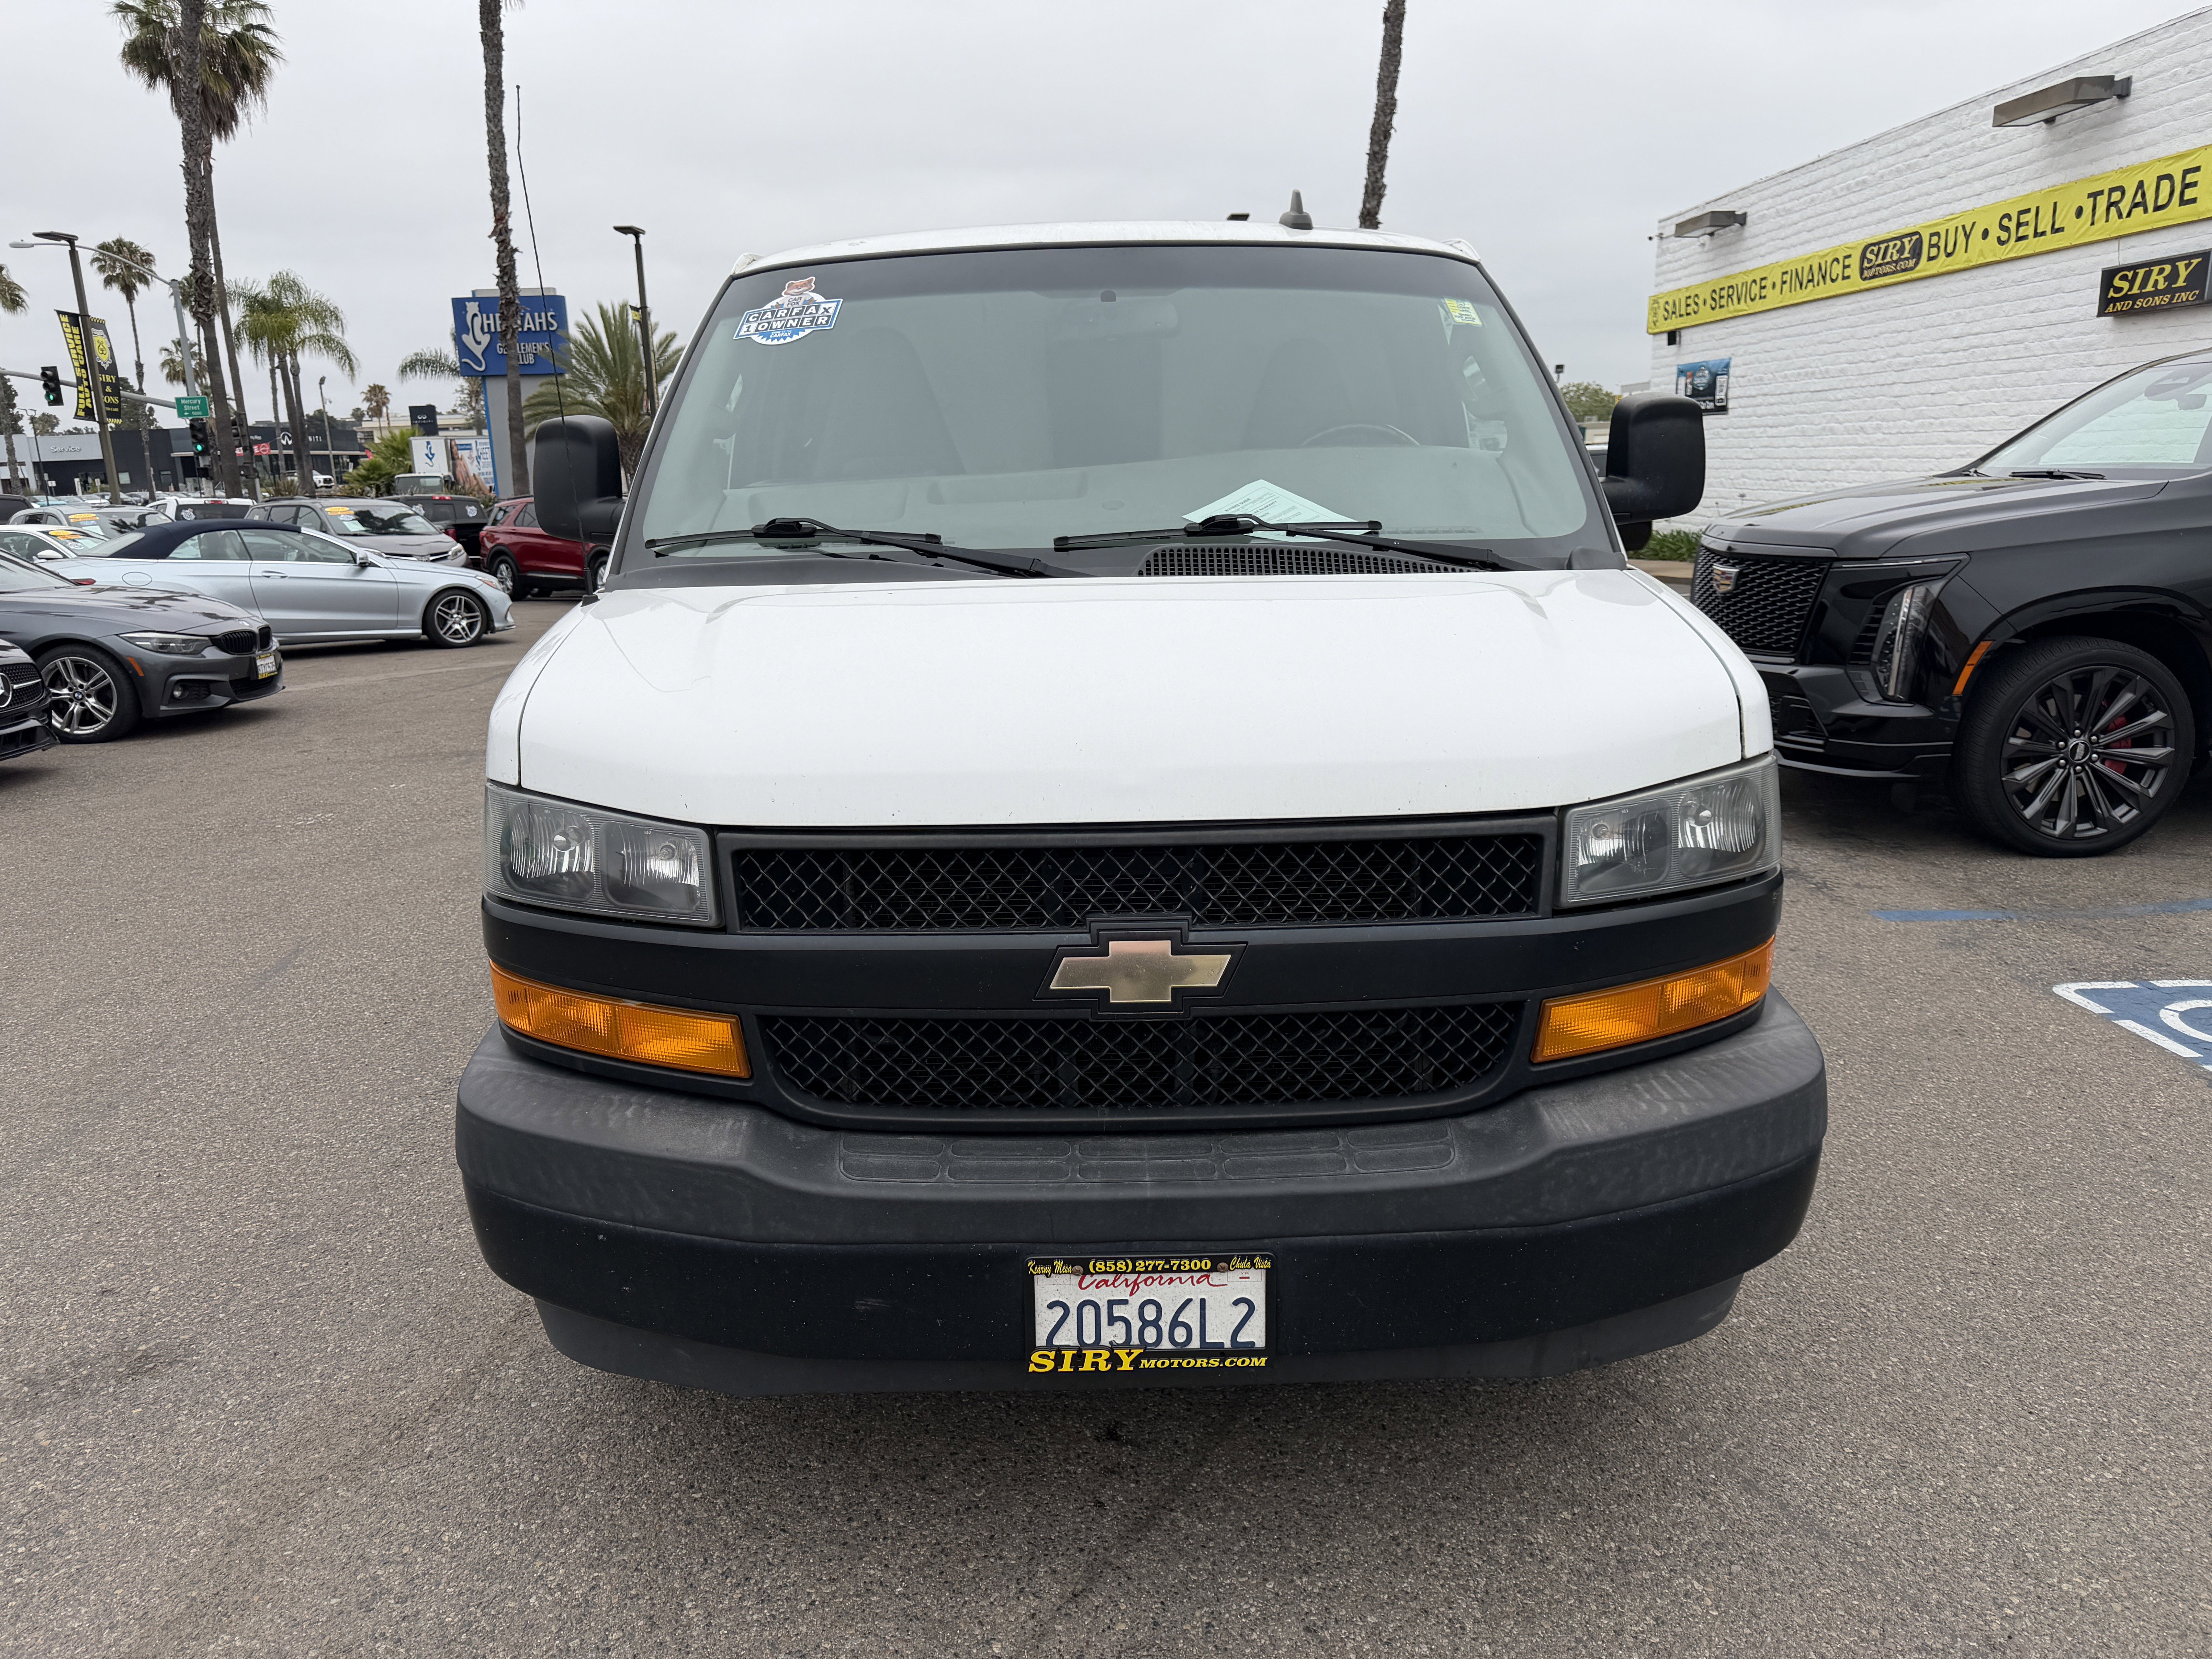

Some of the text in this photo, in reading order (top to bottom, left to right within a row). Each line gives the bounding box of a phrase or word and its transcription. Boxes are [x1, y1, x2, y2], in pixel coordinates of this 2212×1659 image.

[1927, 165, 2202, 262] BUY SELL TRADE
[1863, 235, 1919, 268] SIRY
[1862, 258, 1917, 279] MOTORS.COM
[2107, 258, 2202, 299] SIRY
[1663, 294, 1700, 321] SALES
[1709, 276, 1767, 310] SERVICE
[1781, 254, 1852, 295] FINANCE
[748, 306, 833, 322] CARFAX
[2105, 290, 2200, 314] AND SONS INC
[758, 316, 828, 330] OWNER
[60, 314, 85, 416] FULL SERVICE
[71, 326, 92, 409] AUTO CARE
[517, 353, 534, 364] LUB
[102, 396, 119, 404] ONS
[1028, 1259, 1072, 1277] Kearny Mesa
[1089, 1259, 1211, 1273] (858) 277-7300
[1230, 1256, 1272, 1271] Chula Vista
[1078, 1273, 1228, 1297] California
[1046, 1297, 1255, 1348] 20586L2
